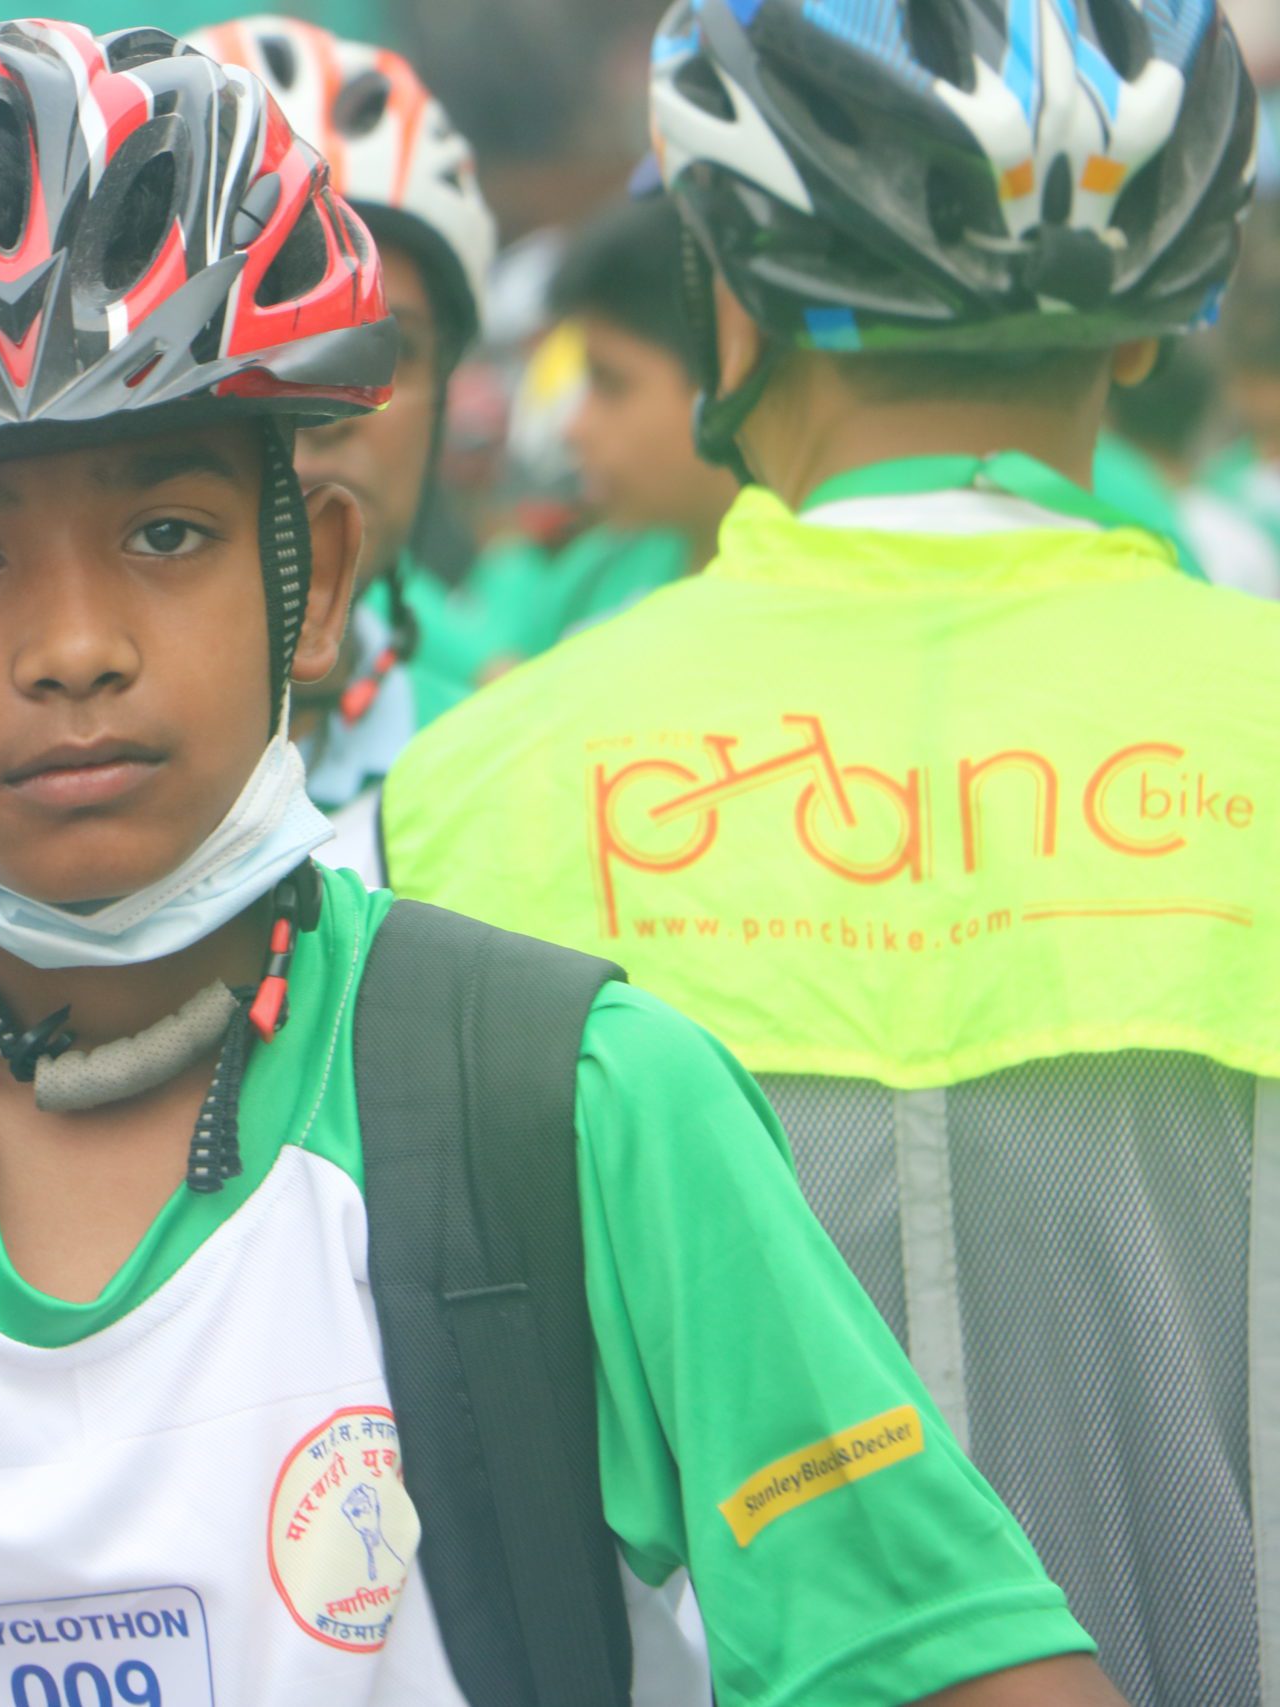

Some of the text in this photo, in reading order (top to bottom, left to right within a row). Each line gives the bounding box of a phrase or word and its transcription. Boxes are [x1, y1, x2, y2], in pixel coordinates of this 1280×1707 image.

[1139, 771, 1255, 829] bike
[633, 907, 1013, 952] www.pancbike.com
[10, 1658, 162, 1707] 009
